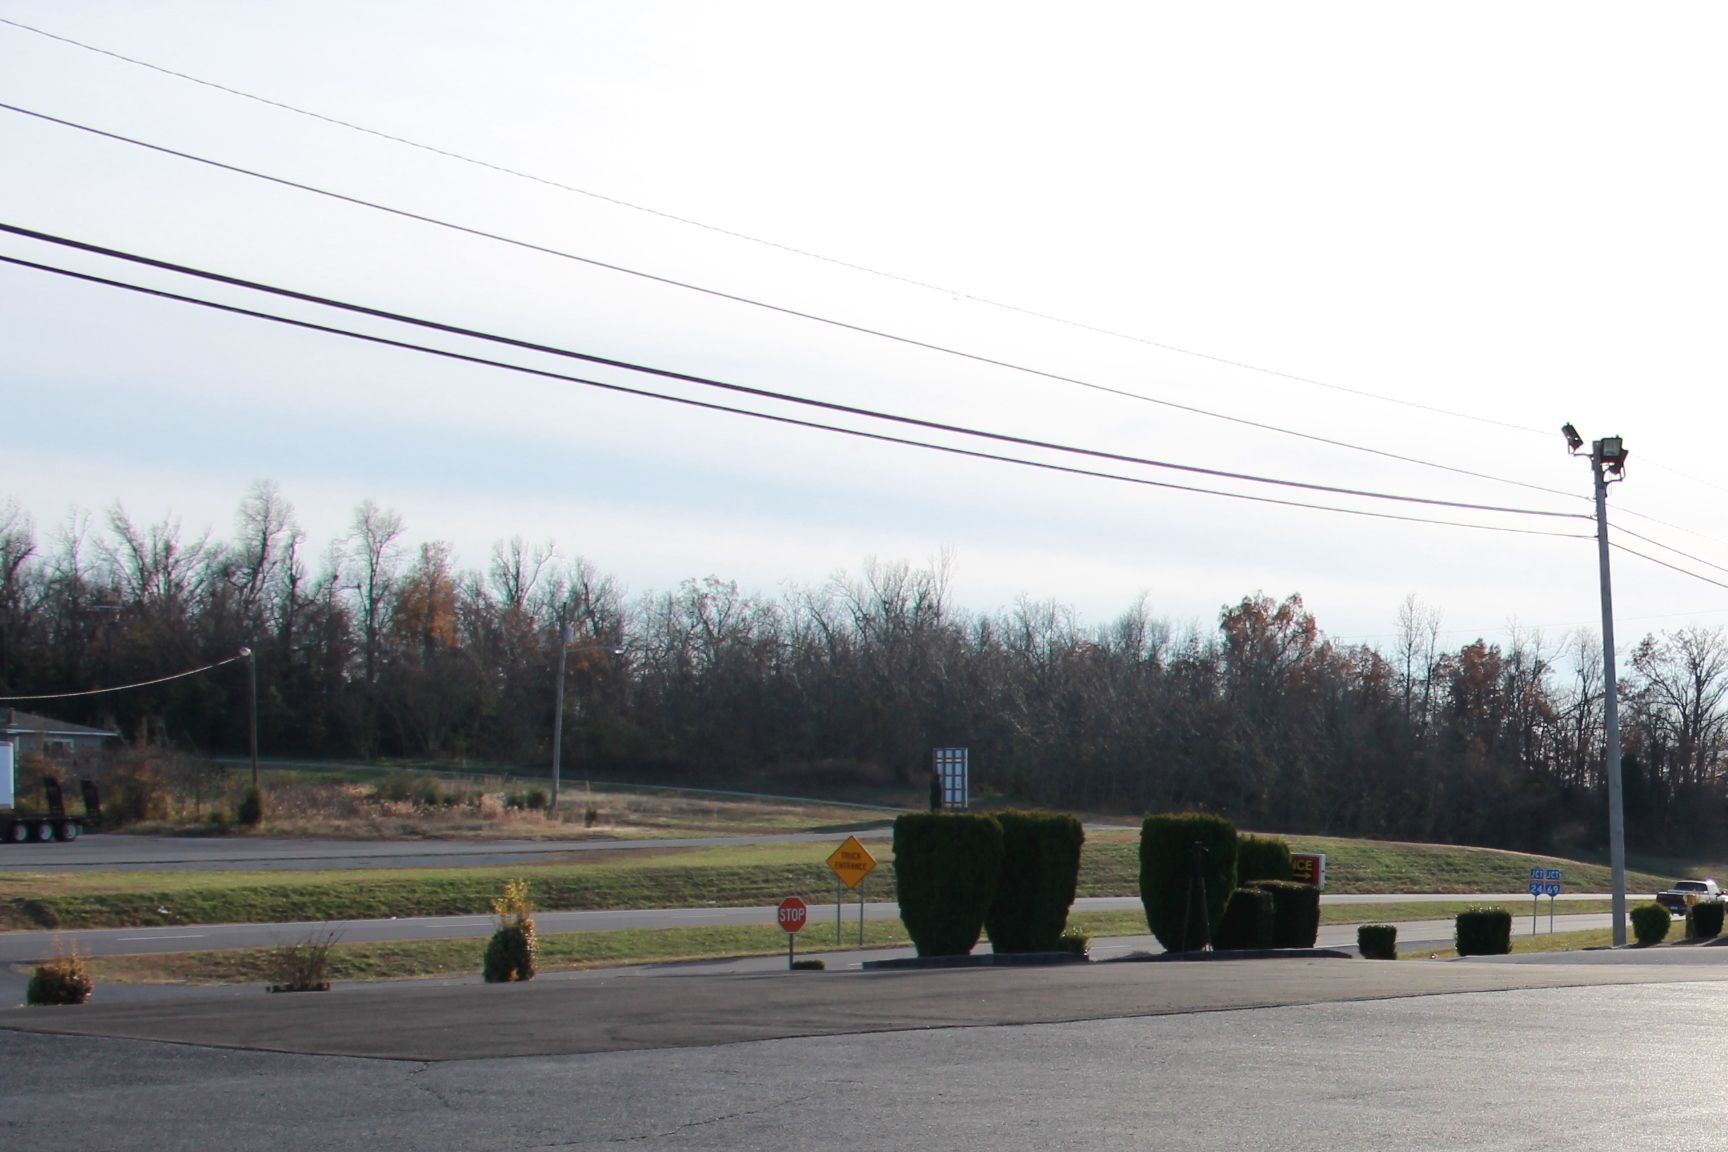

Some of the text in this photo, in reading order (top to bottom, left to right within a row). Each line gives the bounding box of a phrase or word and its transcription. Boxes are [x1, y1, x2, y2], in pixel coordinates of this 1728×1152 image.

[1531, 870, 1544, 878] JCT
[1530, 884, 1543, 893] 24
[1547, 885, 1559, 894] 69
[779, 908, 805, 922] STOP
